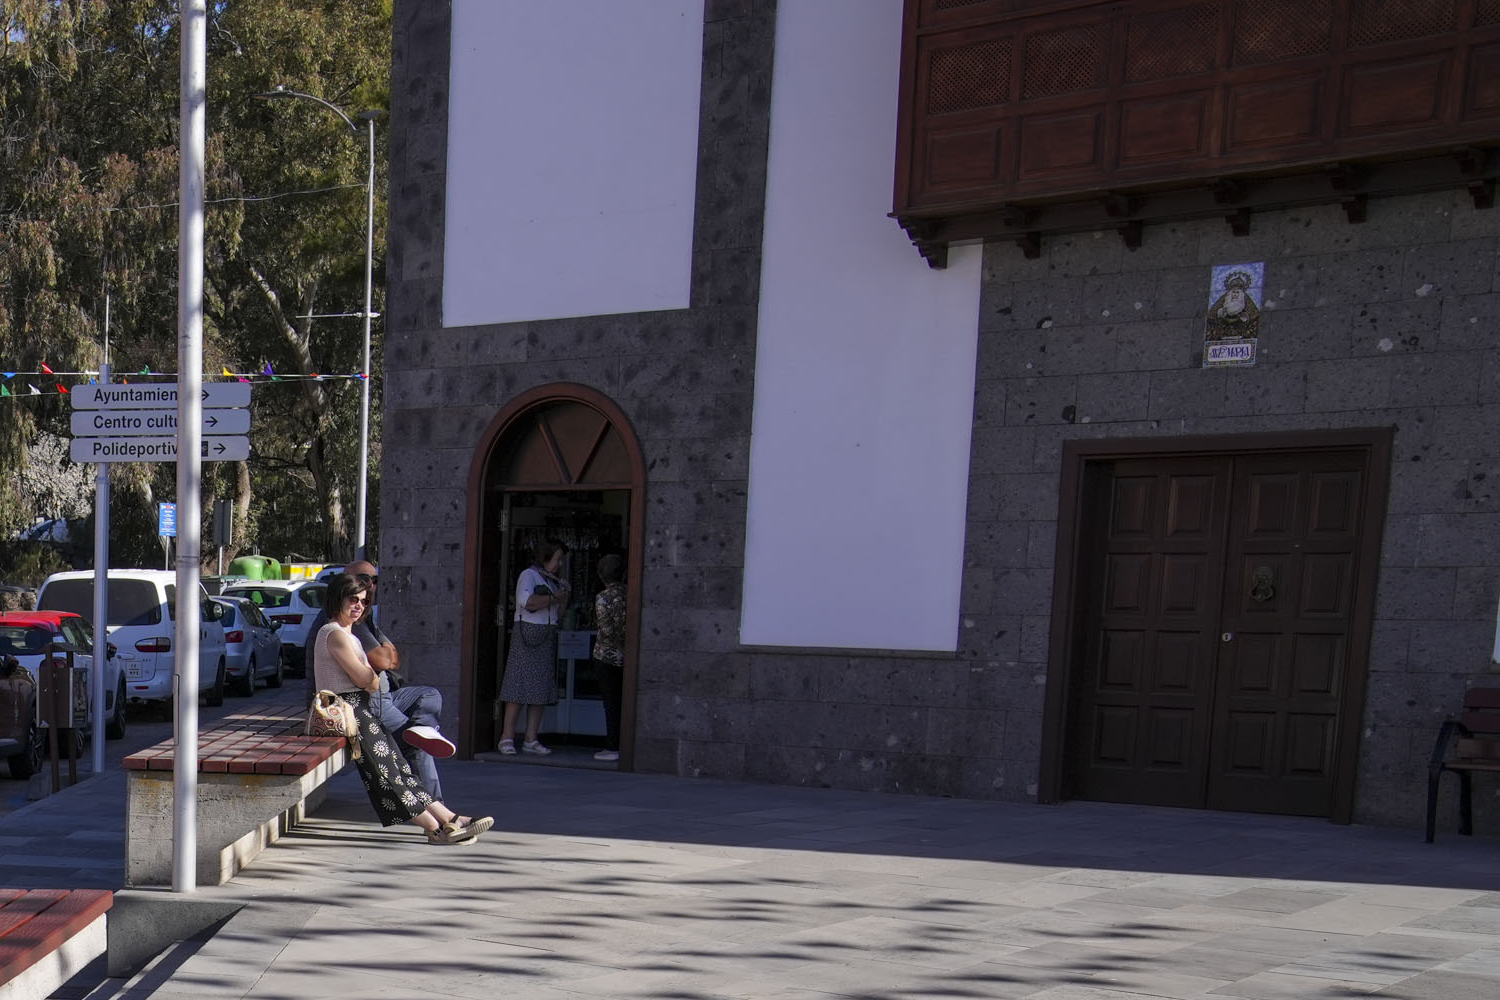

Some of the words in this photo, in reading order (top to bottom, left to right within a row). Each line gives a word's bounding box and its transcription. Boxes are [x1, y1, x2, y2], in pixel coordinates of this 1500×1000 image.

[94, 388, 178, 404] Ayuntamien
[93, 415, 141, 429] Centro
[93, 441, 178, 458] Polideportiv
